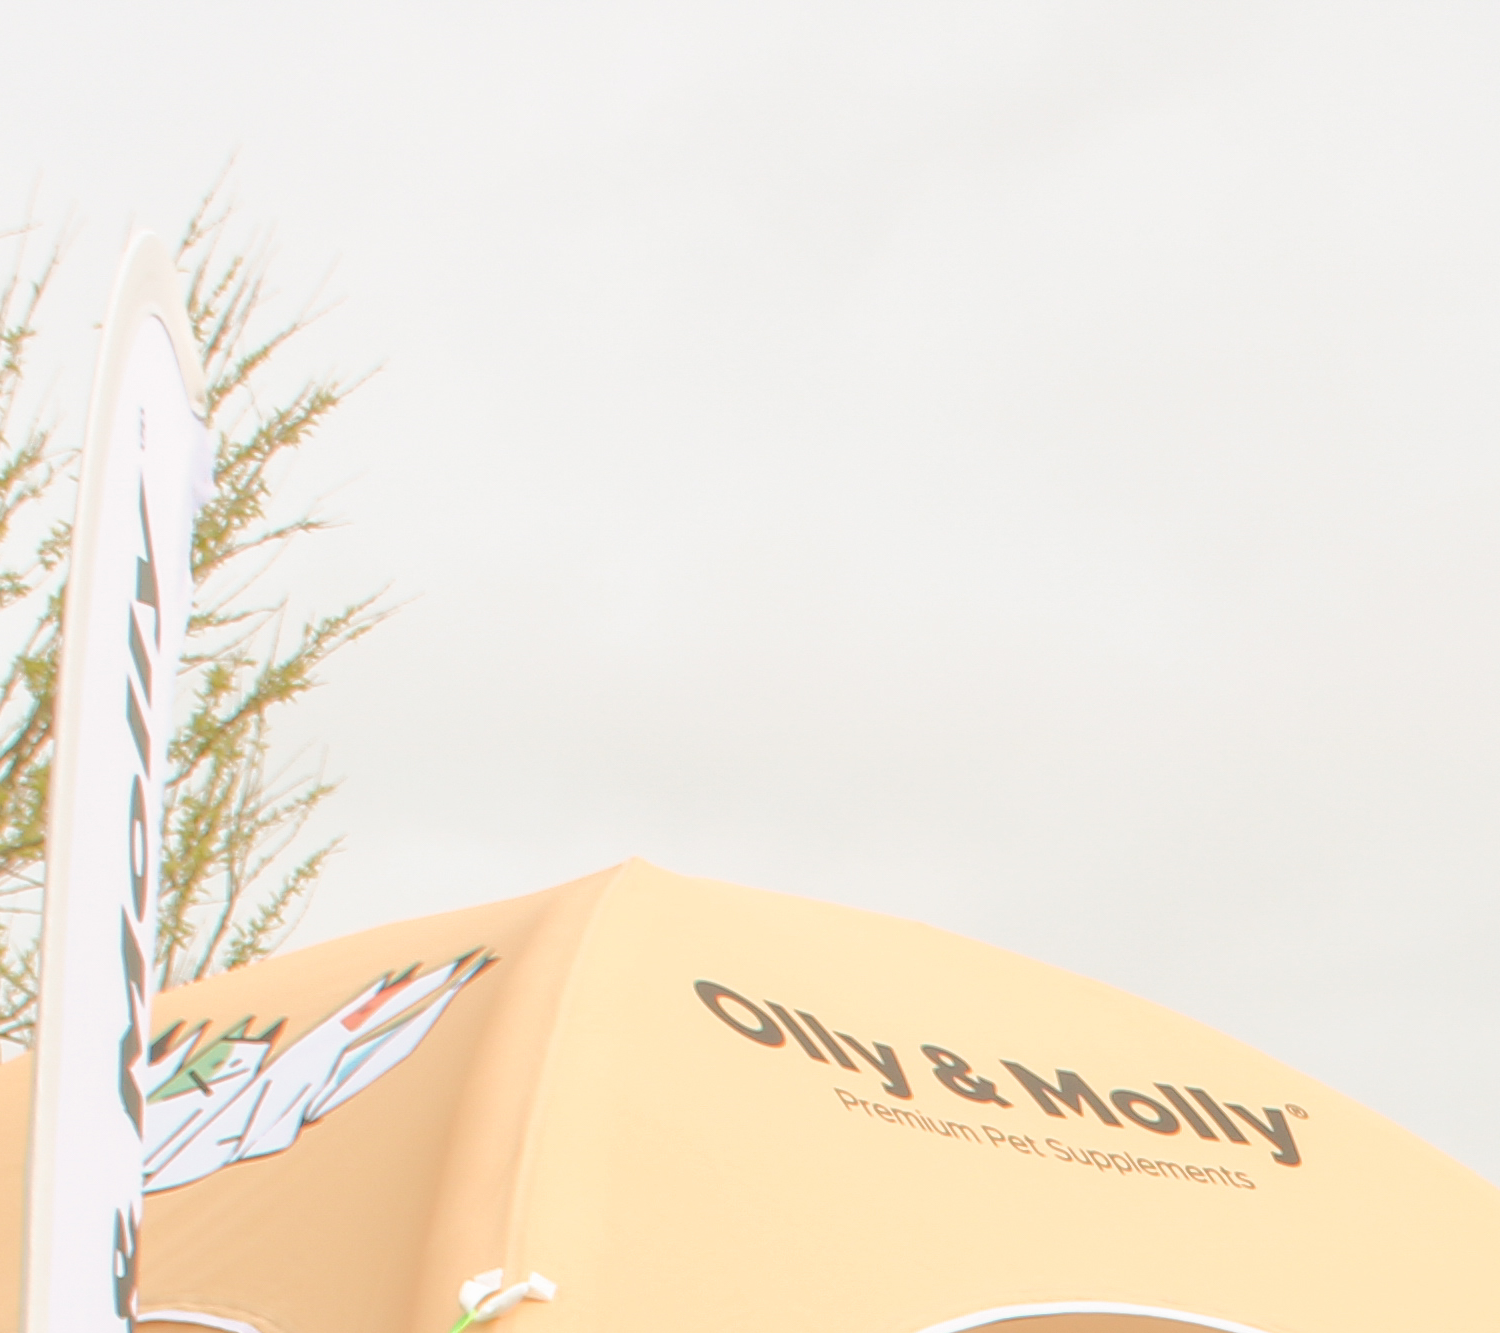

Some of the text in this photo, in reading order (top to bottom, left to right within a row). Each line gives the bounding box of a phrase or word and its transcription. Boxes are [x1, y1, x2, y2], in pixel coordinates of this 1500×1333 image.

[116, 470, 161, 1142] Molly
[694, 980, 914, 1100] Olly
[921, 1044, 1014, 1109] &
[833, 1086, 1257, 1191] Premium Pet Supplements
